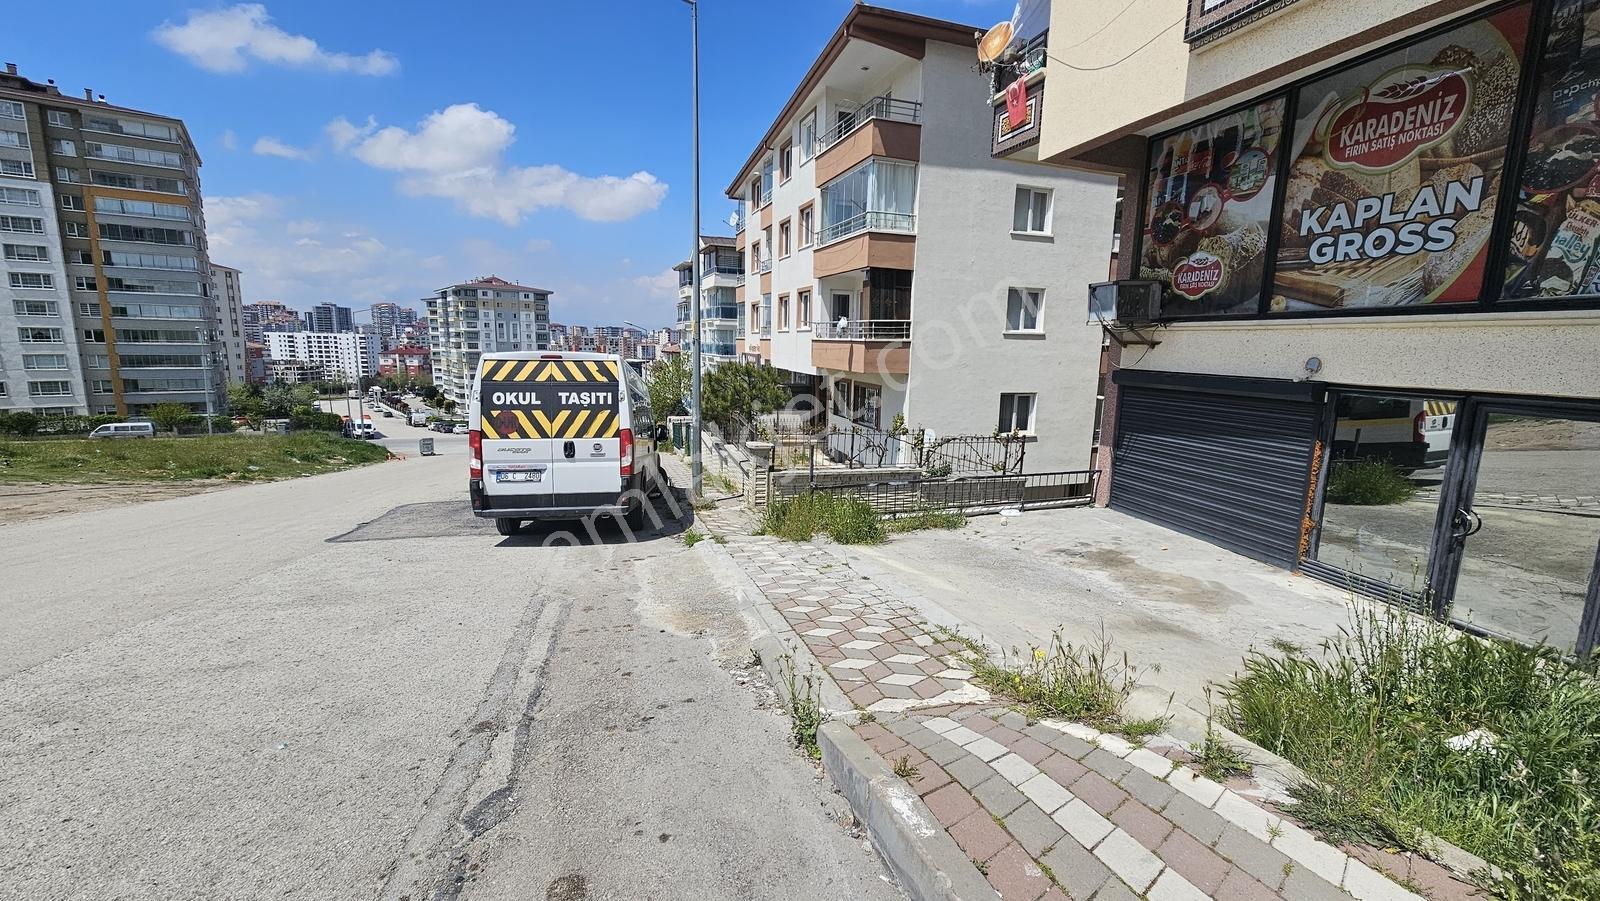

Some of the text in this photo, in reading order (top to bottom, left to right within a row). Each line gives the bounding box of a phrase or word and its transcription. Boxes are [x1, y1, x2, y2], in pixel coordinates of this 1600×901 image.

[1339, 91, 1458, 149] KARADENİZ
[1345, 123, 1445, 158] FIRIN SATIŞ NOKTASI
[1299, 175, 1484, 237] KAPLAN
[1308, 218, 1458, 265] GROSS
[1177, 266, 1220, 284] KARADENİZ
[492, 391, 612, 407] OKUL TAŞITI
[501, 472, 540, 480] 06 C 2480
